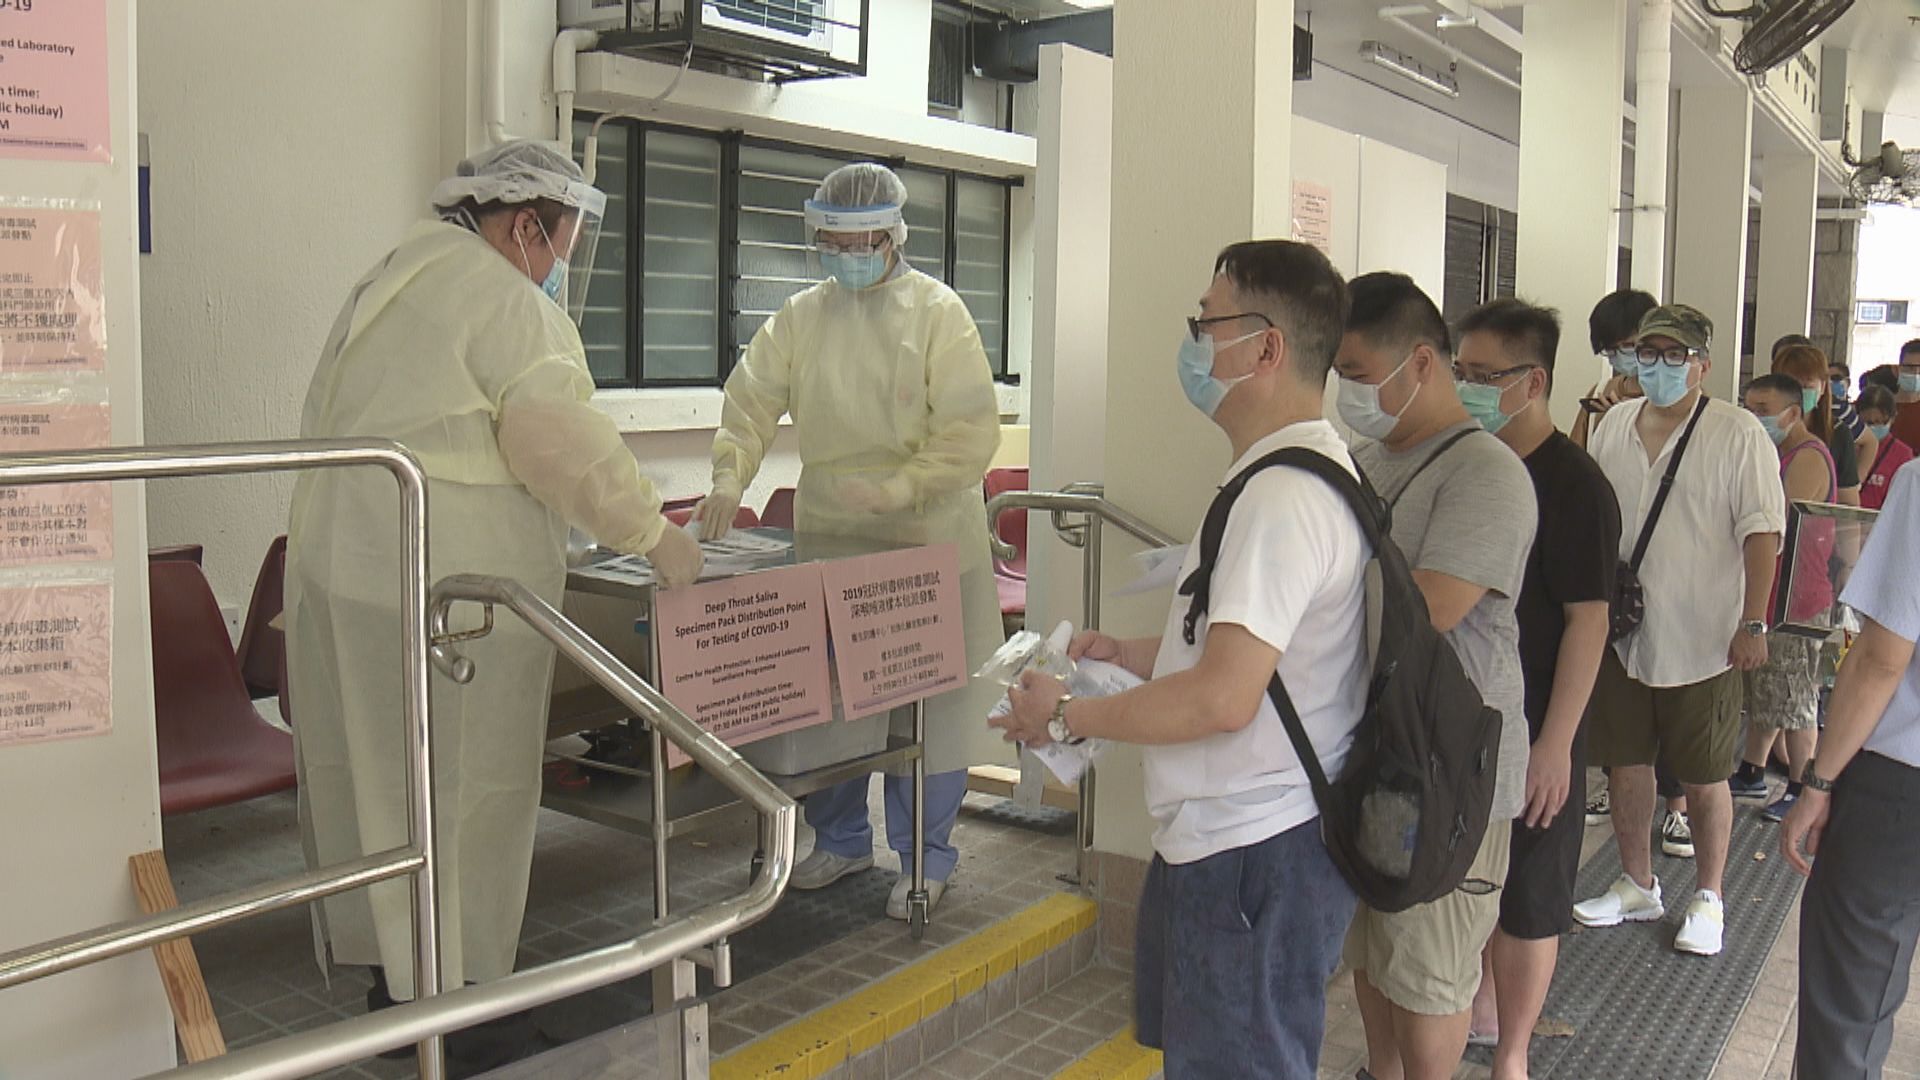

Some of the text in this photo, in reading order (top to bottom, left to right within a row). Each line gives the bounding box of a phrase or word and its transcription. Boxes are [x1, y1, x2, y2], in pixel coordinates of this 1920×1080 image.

[17, 39, 75, 56] Laboratory
[8, 85, 40, 98] time:
[15, 103, 64, 119] holiday)
[705, 591, 778, 615] Deep Throat Saliva
[675, 601, 807, 638] Specimen Pack Distribution Point
[696, 620, 789, 650] For Testing of COVID-19
[675, 671, 694, 683] Centre
[695, 668, 704, 679] for
[705, 664, 723, 677] Health
[723, 657, 751, 672] Protection
[755, 651, 781, 665] Enhanced
[782, 645, 810, 659] Laboratory
[745, 663, 776, 678] Programme
[696, 699, 726, 713] Specimen
[727, 695, 741, 707] pack
[742, 685, 777, 701] distribution
[711, 713, 719, 722] to
[719, 706, 739, 720] Friday
[739, 701, 762, 716] (except
[762, 696, 780, 710] public
[781, 688, 806, 703] holiday)
[731, 716, 743, 727] AM
[768, 707, 780, 717] AM
